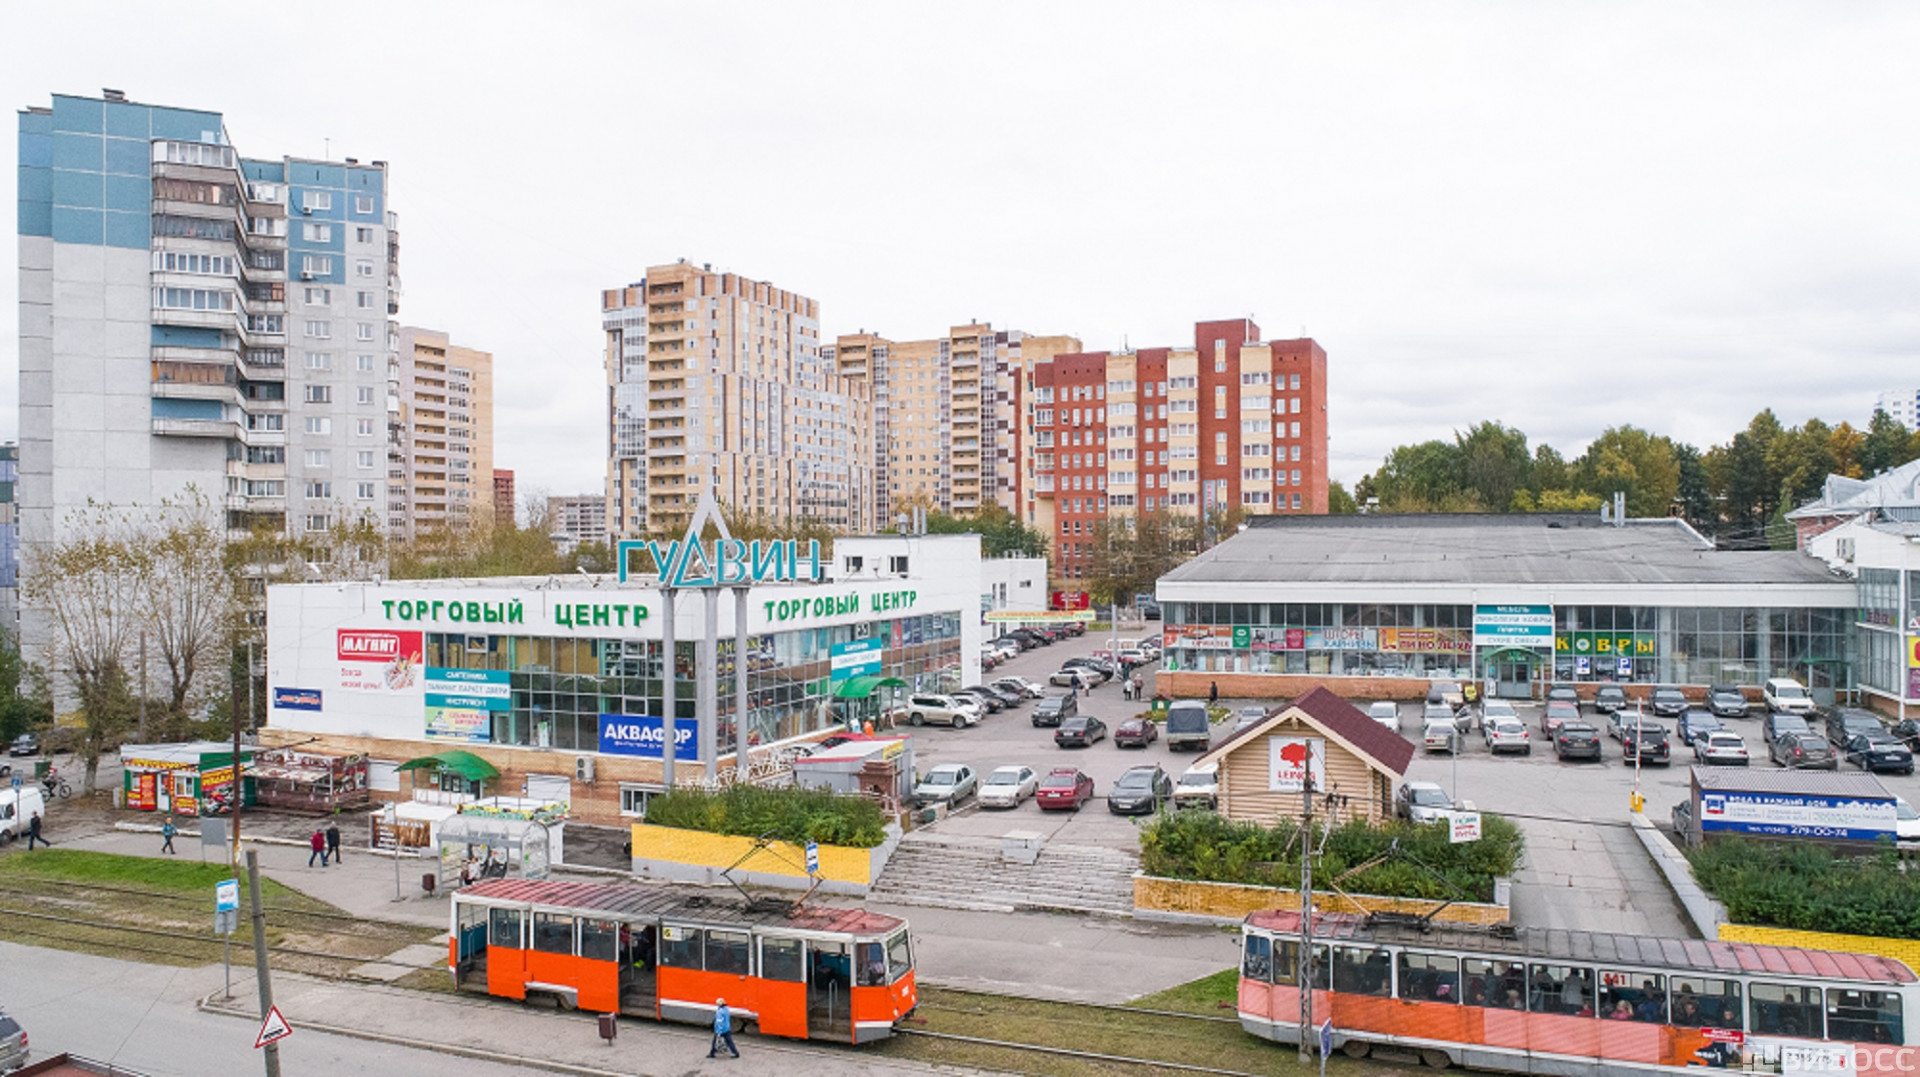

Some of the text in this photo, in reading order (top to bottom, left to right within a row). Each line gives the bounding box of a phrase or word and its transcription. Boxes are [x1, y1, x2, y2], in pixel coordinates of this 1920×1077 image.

[618, 531, 820, 586] ГУДВИН
[382, 598, 649, 629] ТОРГОВЫЙ ЦЕНТР
[764, 590, 918, 621] ТОРГОВЫЙ ЦЕНТР
[1324, 629, 1364, 639] ШТОРЫ
[342, 637, 396, 653] МАГНИТ
[1323, 639, 1376, 650] КАРНИЗЫ
[1399, 640, 1473, 650] ЛИНОЛЕУМ
[1556, 636, 1654, 654] КОВРЫ
